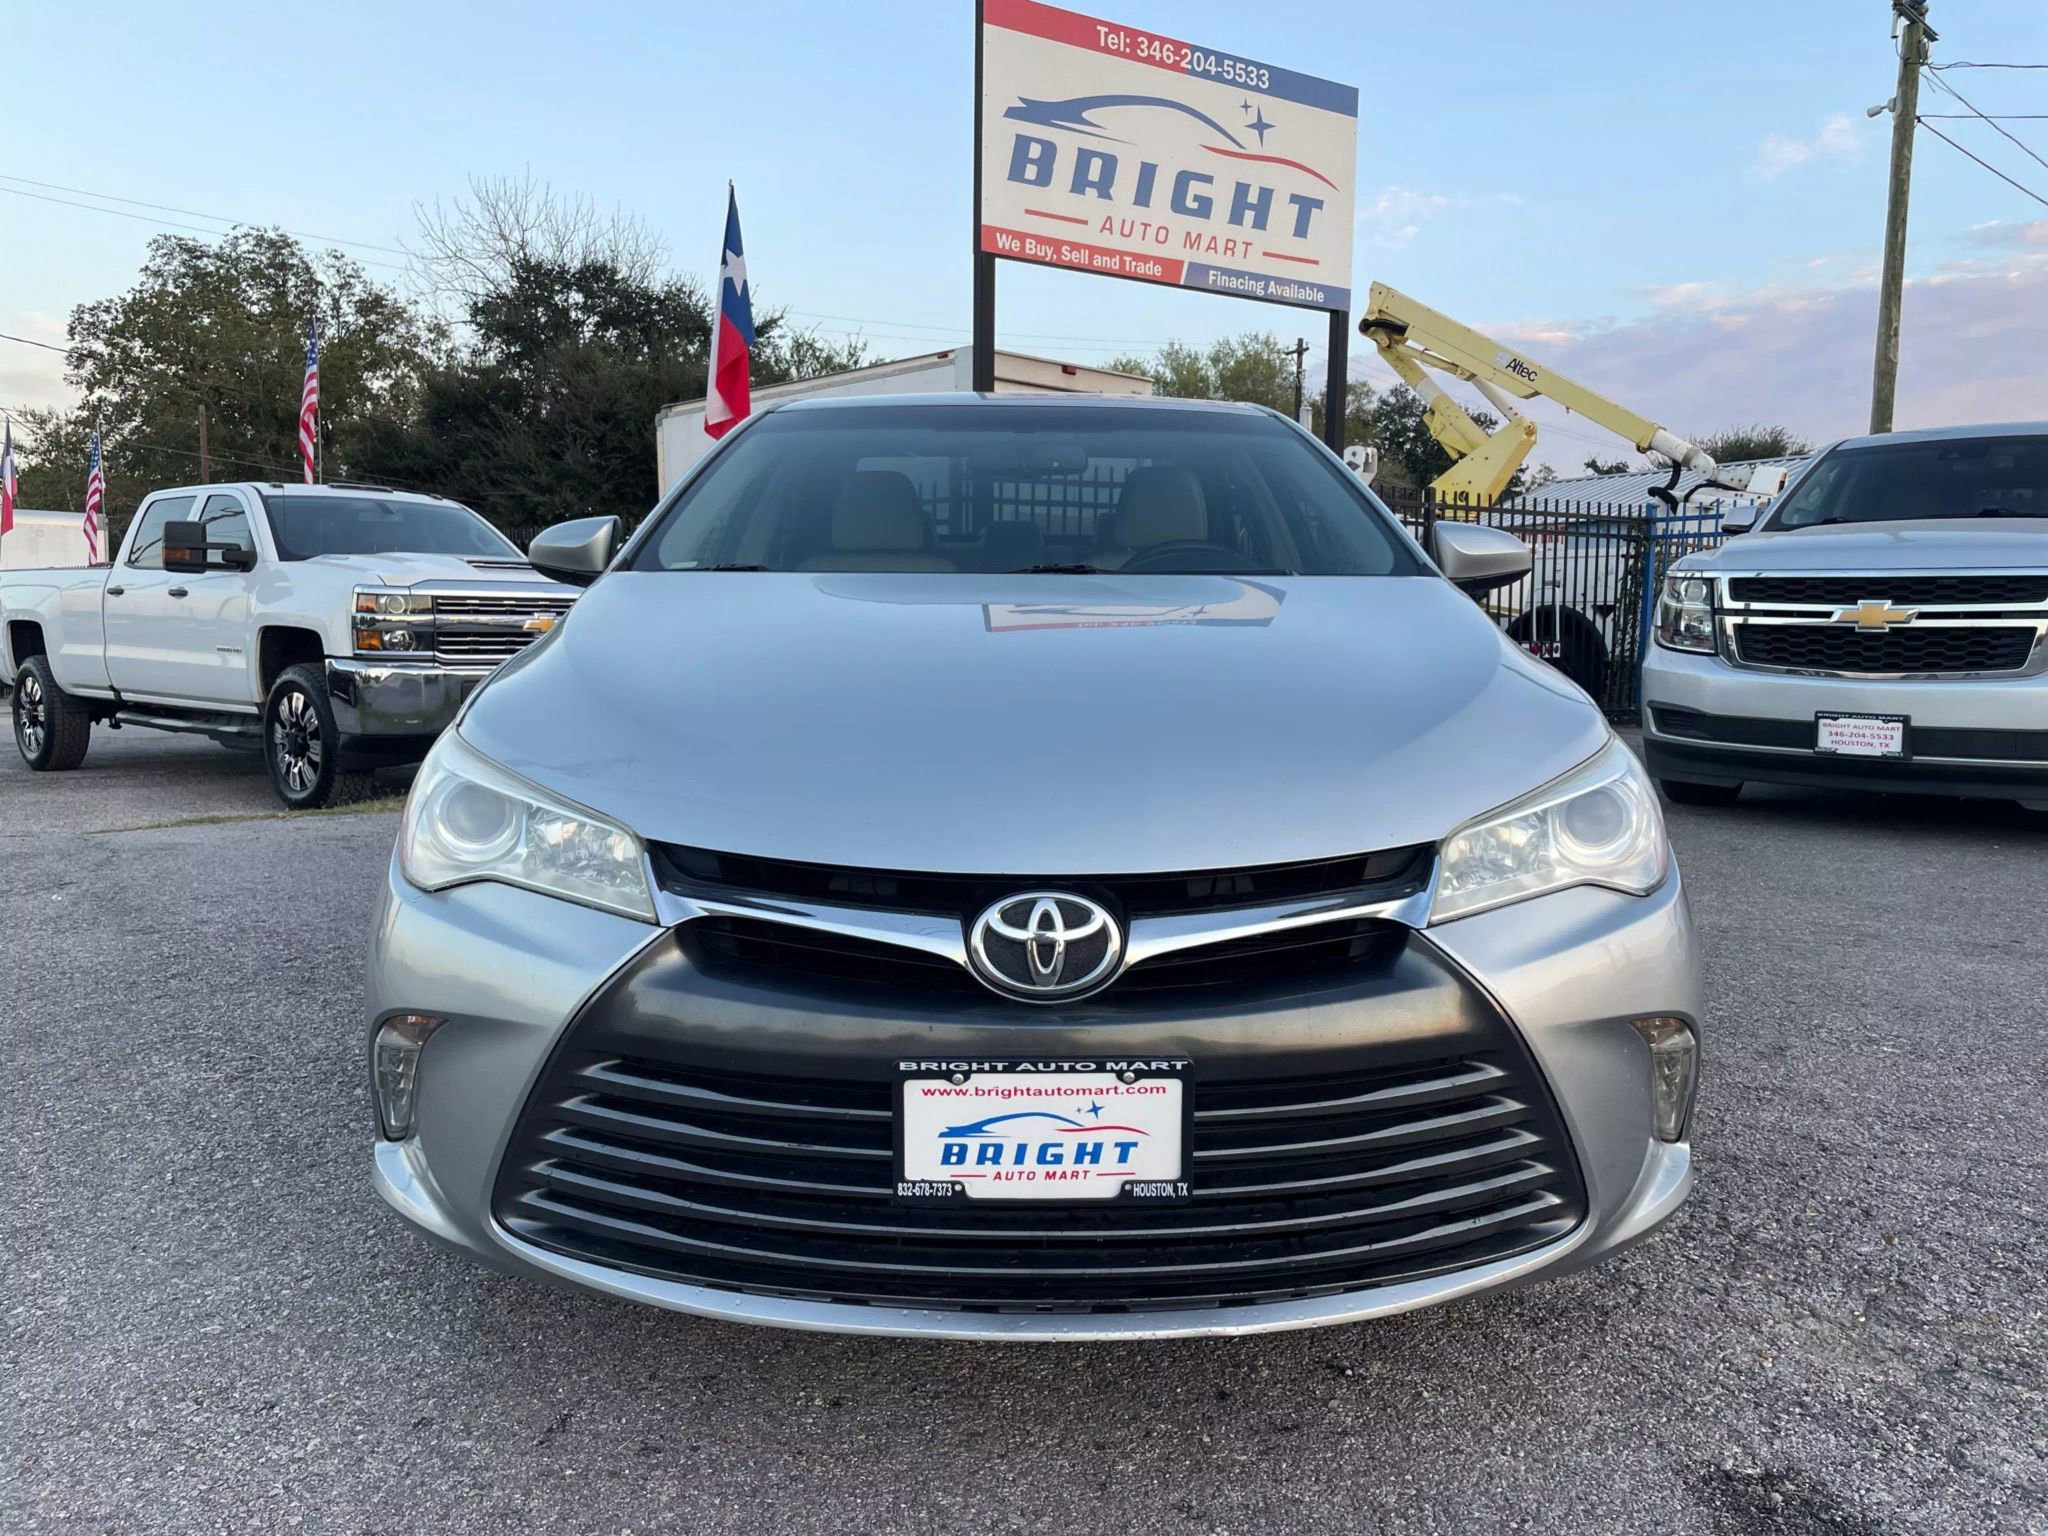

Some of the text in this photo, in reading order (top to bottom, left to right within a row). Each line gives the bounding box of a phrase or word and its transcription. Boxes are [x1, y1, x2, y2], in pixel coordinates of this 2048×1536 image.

[1096, 25, 1270, 90] Tel: 346-204-5533
[1006, 132, 1325, 240] BRIGHT
[1099, 215, 1253, 260] AUTO MART
[996, 232, 1162, 277] We Buy, Sell and Trade
[1208, 270, 1325, 303] Finacing Available
[1505, 358, 1537, 382] Altec
[1828, 730, 1894, 741] 346-204-5533
[1831, 739, 1877, 749] HOUSTON,
[899, 1060, 1188, 1072] BRIGHT AUTO MART
[921, 1084, 1167, 1100] www.brightautomart.com
[940, 1141, 1139, 1166] BRIGHT
[993, 1169, 1091, 1182] AUTO MART
[897, 1183, 952, 1197] 832-678-7373
[1133, 1182, 1188, 1198] HOUSTON, TX
